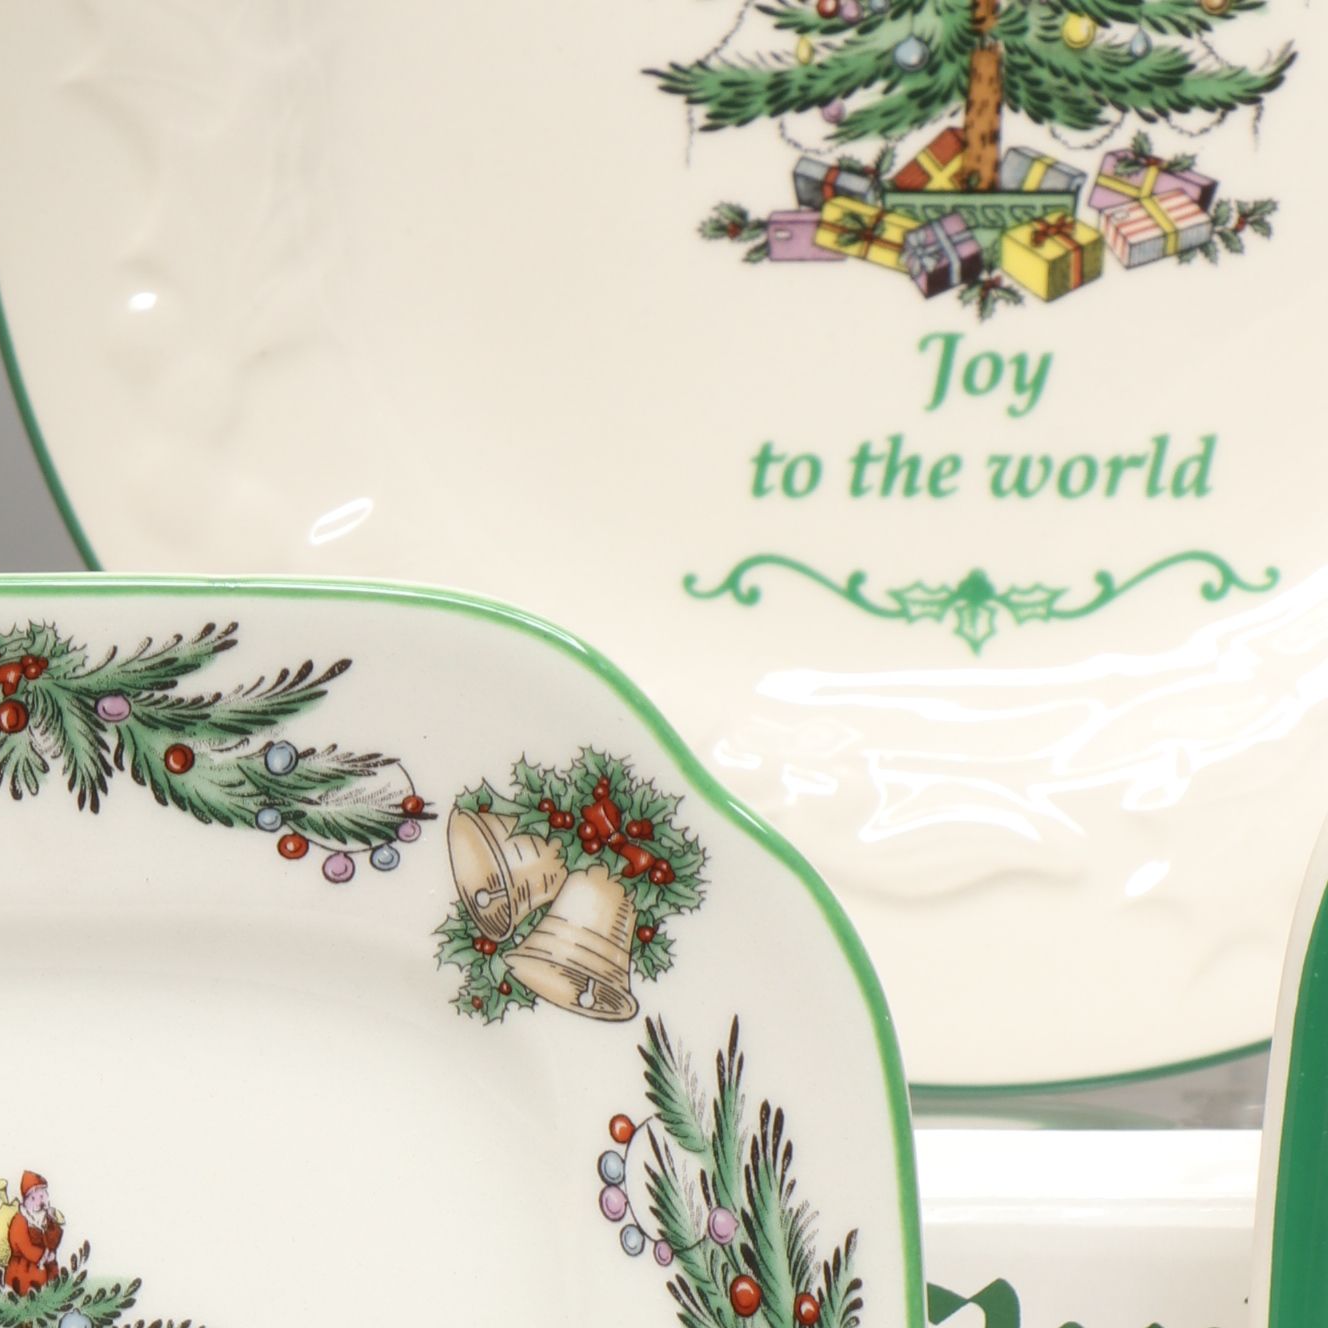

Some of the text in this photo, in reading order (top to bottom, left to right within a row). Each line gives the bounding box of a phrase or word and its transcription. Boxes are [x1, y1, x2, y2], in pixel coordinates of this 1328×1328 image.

[918, 331, 1054, 418] Joy
[750, 432, 1218, 500] to the world
